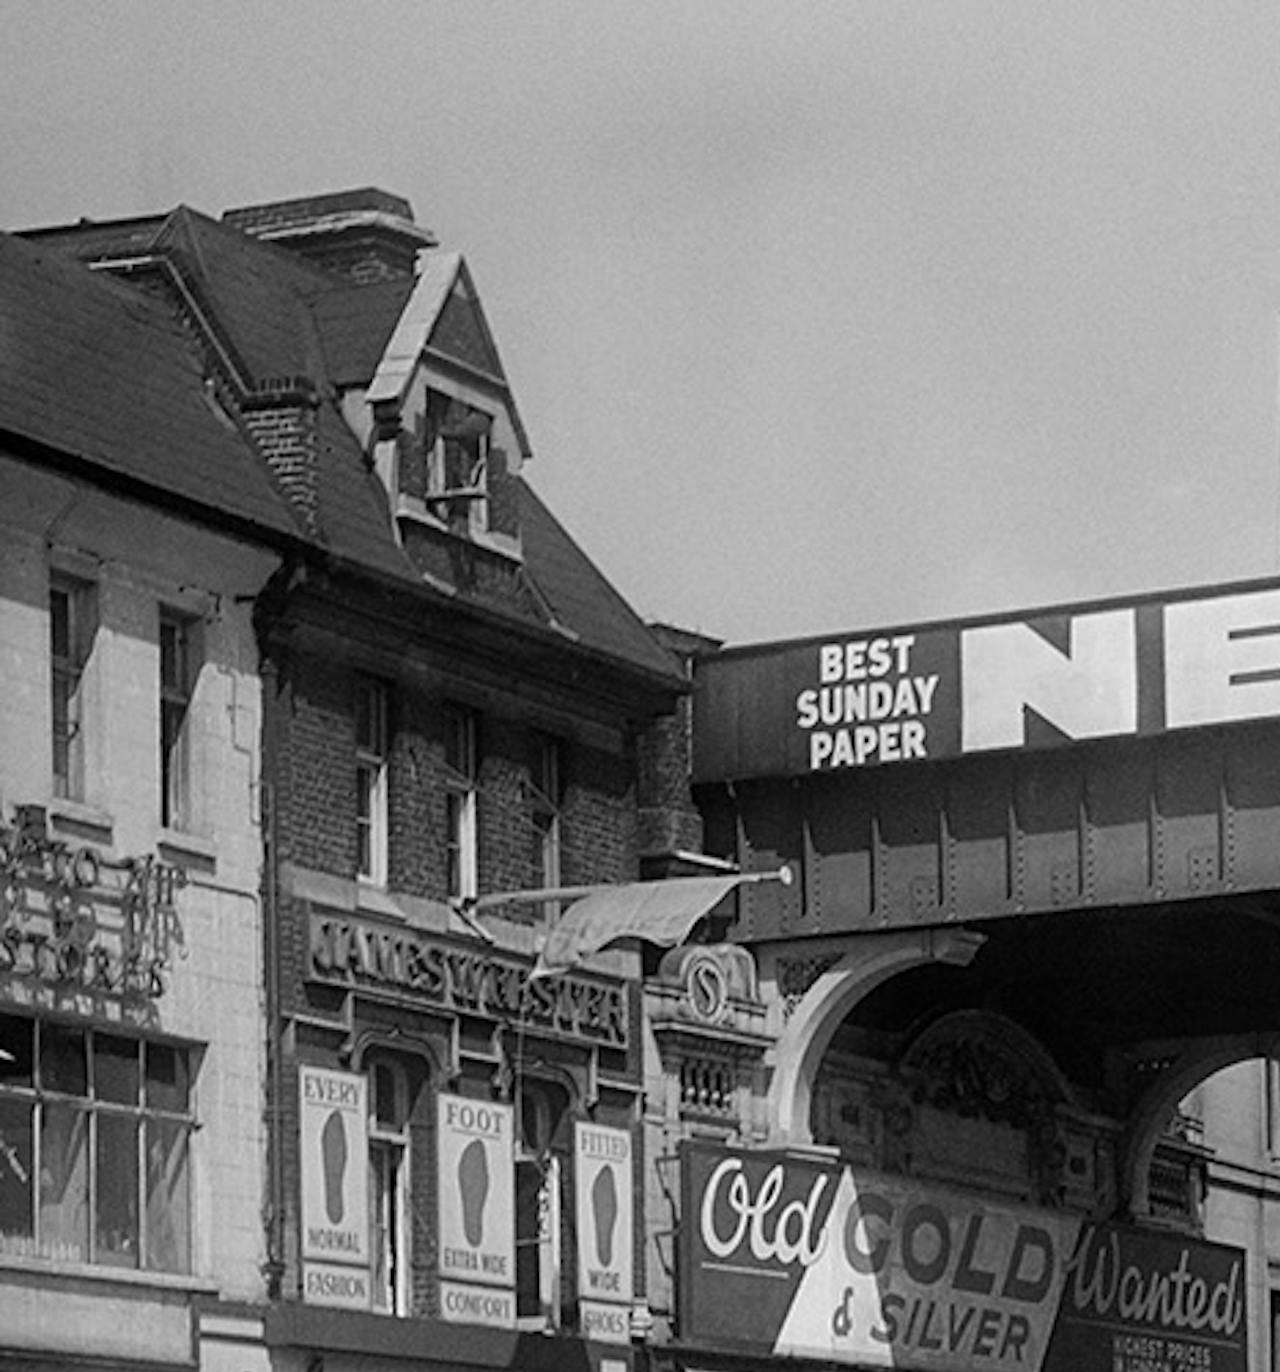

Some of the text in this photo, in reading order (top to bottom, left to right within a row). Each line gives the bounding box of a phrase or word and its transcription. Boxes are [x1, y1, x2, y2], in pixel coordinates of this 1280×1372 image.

[819, 635, 915, 684] BEST
[797, 675, 939, 728] SUNDAY
[810, 722, 926, 770] PAPER
[304, 1075, 360, 1107] EVERY
[446, 1101, 505, 1134] FOOT
[700, 1157, 1242, 1336] Old GOLD Wanted
[481, 1253, 508, 1276] WIDE
[589, 1269, 621, 1292] WIDE
[307, 1273, 366, 1299] FASHION
[446, 1291, 511, 1318] COMFORT
[584, 1309, 626, 1334] SHOES
[871, 1293, 1032, 1363] SILVER
